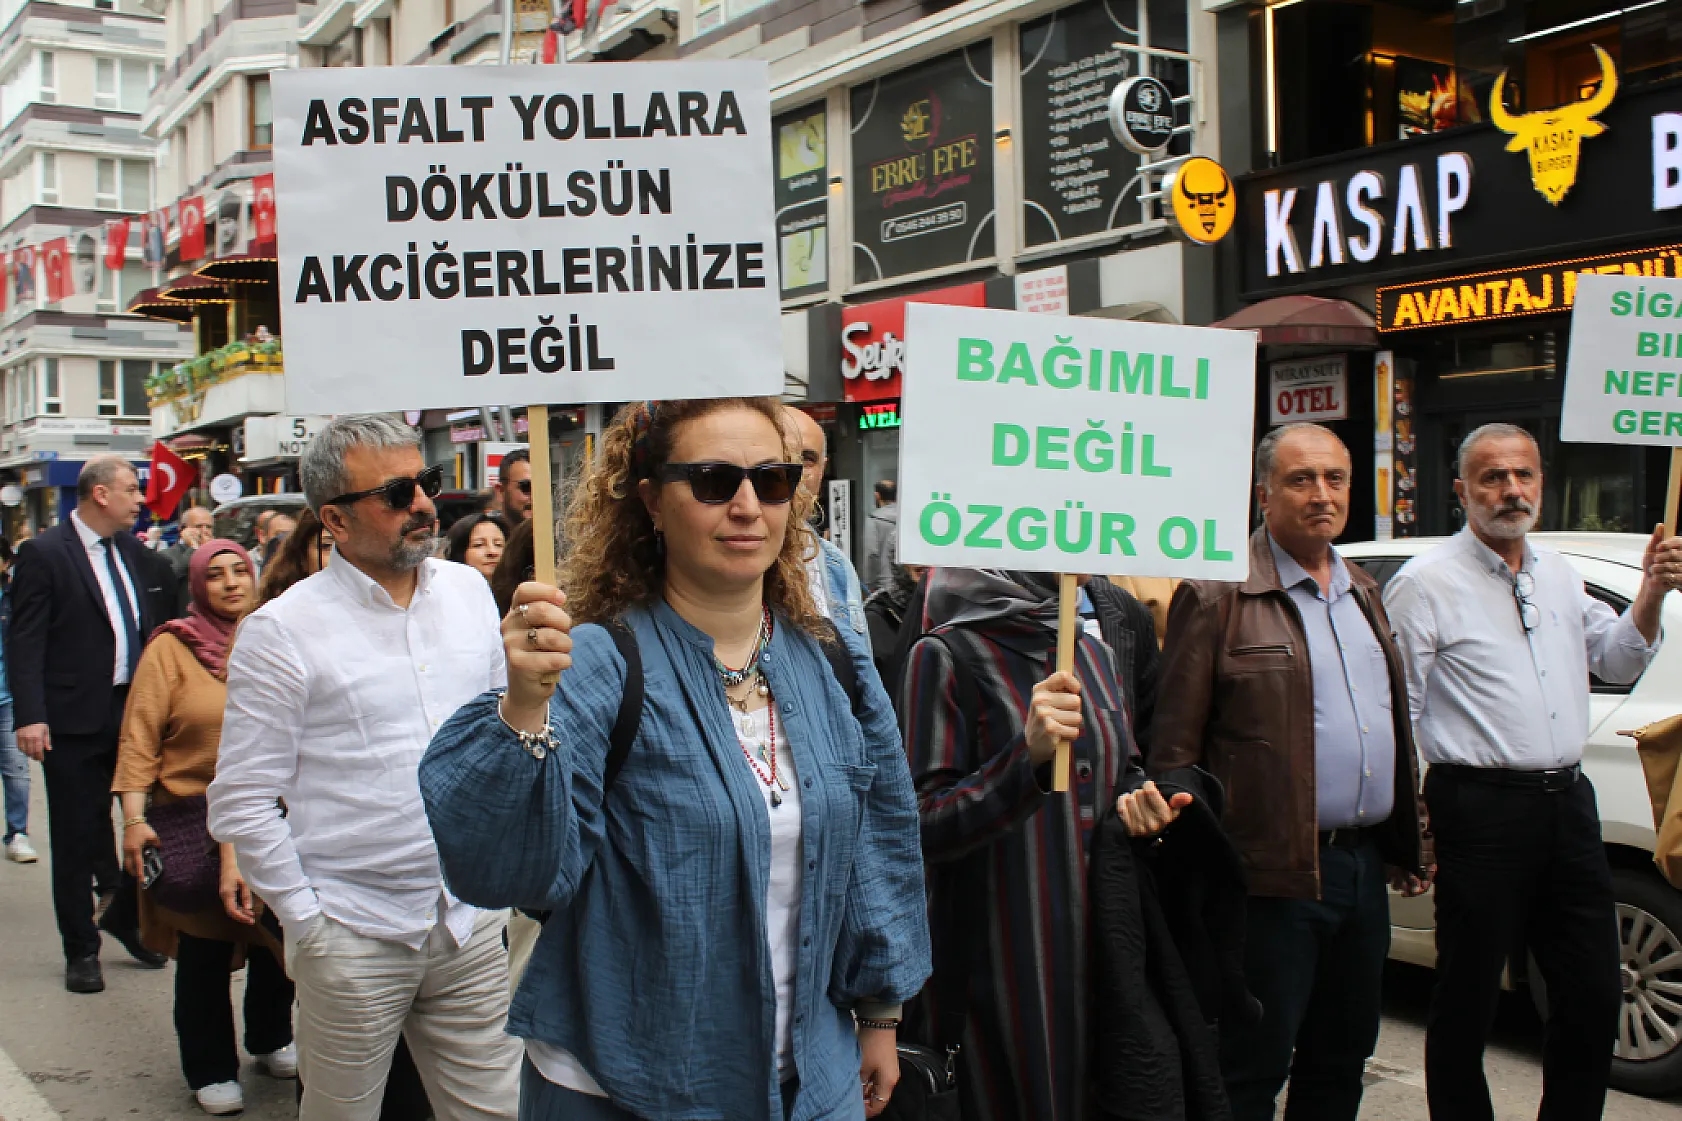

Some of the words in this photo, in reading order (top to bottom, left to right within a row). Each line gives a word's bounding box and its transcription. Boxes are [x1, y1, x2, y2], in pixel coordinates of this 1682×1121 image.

[300, 95, 493, 146] ASFALT
[509, 90, 748, 141] YOLLARA
[1533, 129, 1575, 156] KASAP
[385, 160, 671, 223] DÖKÜLSÜN
[871, 152, 927, 193] EBRU
[933, 138, 977, 176] EFE
[1263, 152, 1473, 278] KASAP
[295, 234, 766, 304] AKCİĞERLERİNİZE
[1393, 273, 1554, 326] AVANTAJ
[460, 314, 615, 377] DEĞİL
[957, 334, 1210, 401] BAĞIMLI
[1277, 386, 1339, 416] OTEL
[1604, 369, 1682, 398] NEF
[991, 418, 1172, 478] DEĞİL
[918, 491, 1138, 557] ÖZGÜR
[1158, 515, 1235, 562] OL
